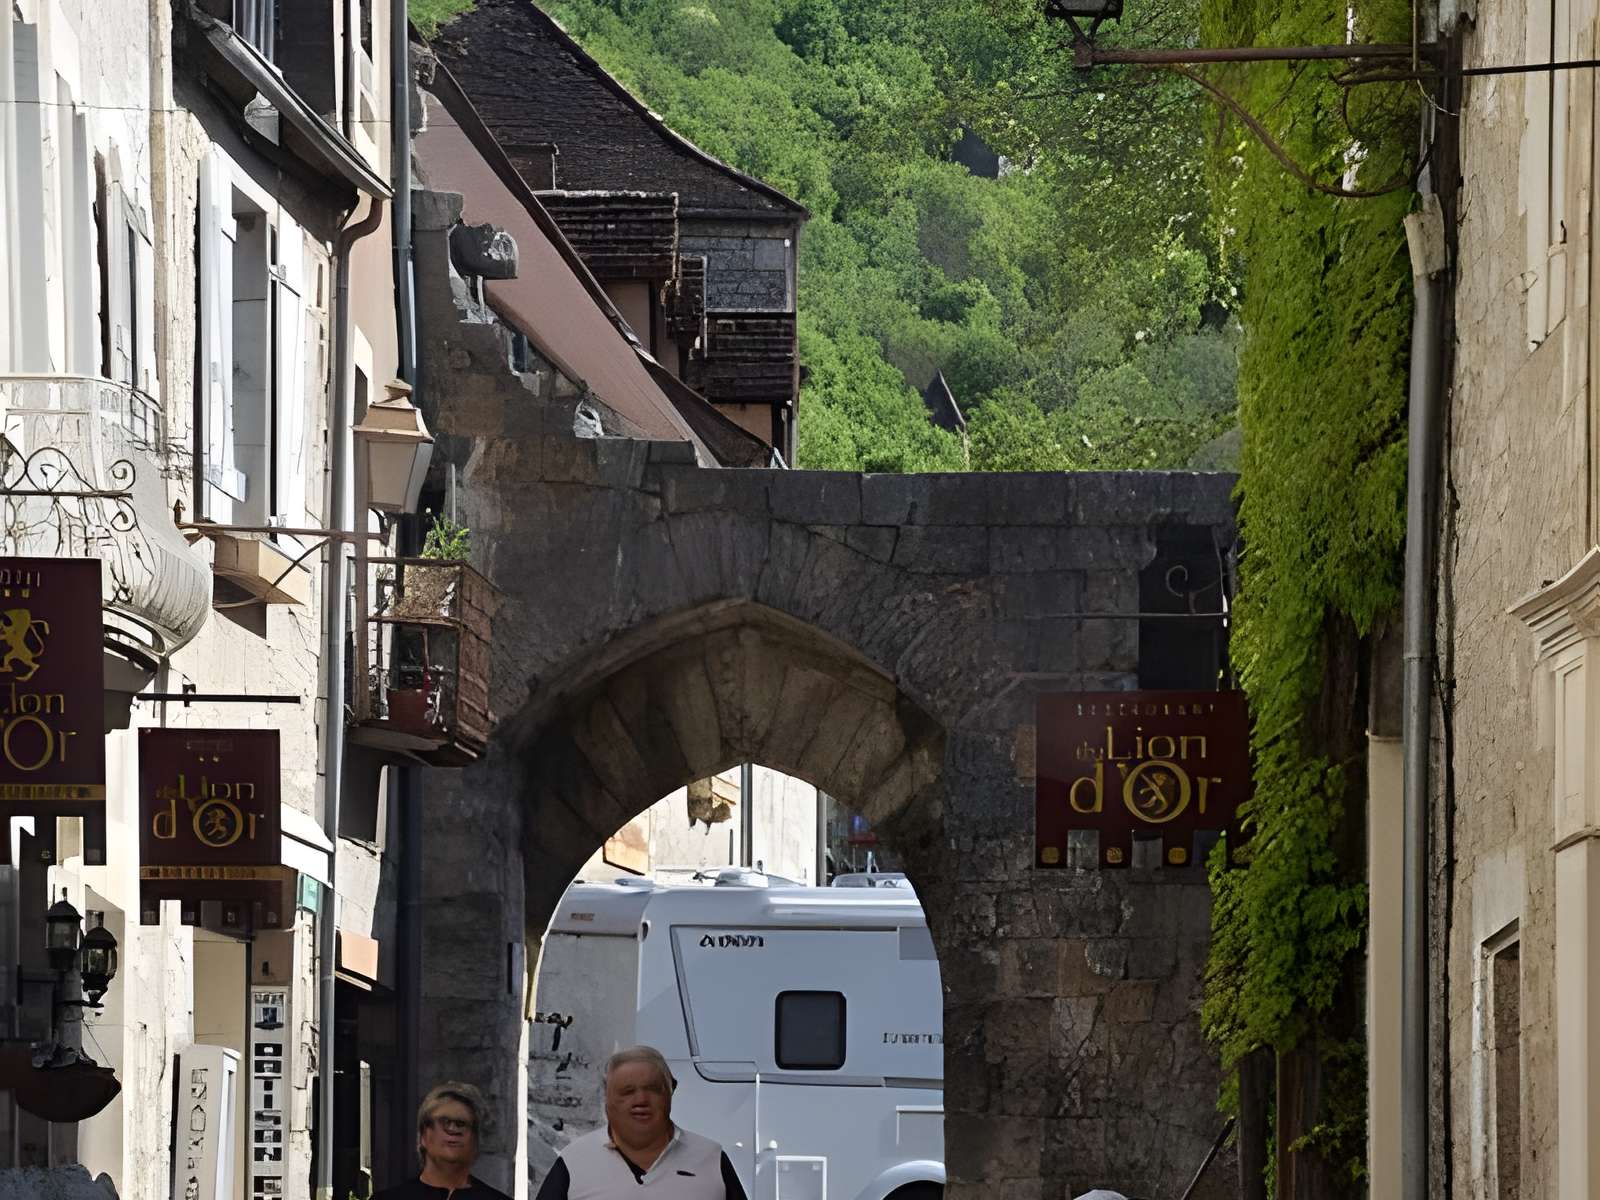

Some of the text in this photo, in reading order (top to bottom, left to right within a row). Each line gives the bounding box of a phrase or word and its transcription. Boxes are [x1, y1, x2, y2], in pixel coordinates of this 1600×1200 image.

[1106, 726, 1206, 760] Lion
[1069, 757, 1222, 823] d'Or
[153, 798, 264, 848] d'Or
